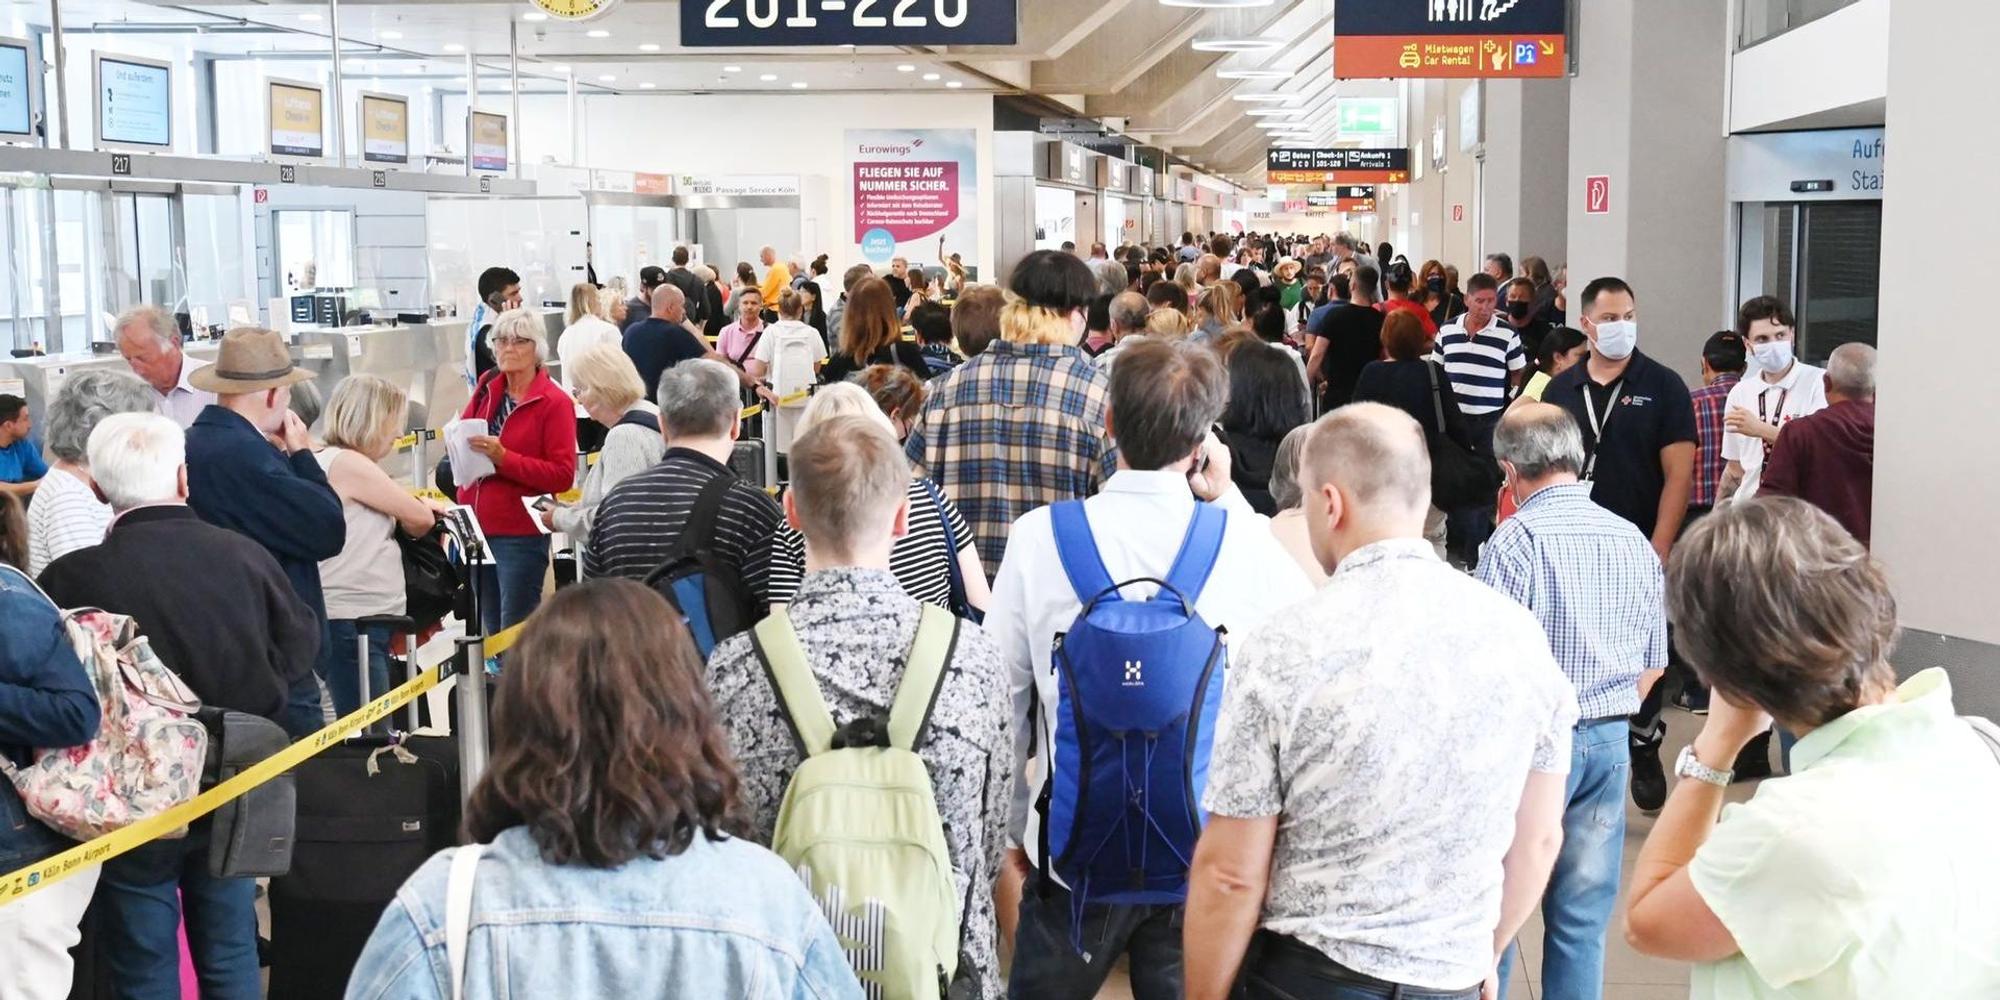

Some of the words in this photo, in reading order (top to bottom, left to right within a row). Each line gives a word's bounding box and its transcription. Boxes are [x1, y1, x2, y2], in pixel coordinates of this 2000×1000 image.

[1425, 44, 1474, 54] Mietwagen
[1424, 56, 1438, 65] Car
[1442, 56, 1471, 65] Rental
[859, 145, 911, 156] Eurowings
[1852, 138, 1885, 159] Auf
[1292, 151, 1311, 159] Gates
[1316, 151, 1344, 159] Check-in
[1361, 151, 1386, 159] Ankunft
[114, 157, 129, 173] 217
[1360, 160, 1385, 168] Arrivals
[282, 167, 294, 182] 218
[860, 167, 901, 178] FLIEGEN
[904, 167, 921, 178] SIE
[922, 167, 944, 178] AUF
[716, 187, 747, 195] Passage
[749, 186, 777, 194] Service
[860, 180, 908, 191] NUMMER
[910, 180, 950, 191] SICHER.
[63, 857, 82, 872] Bonn
[83, 843, 111, 861] Airport
